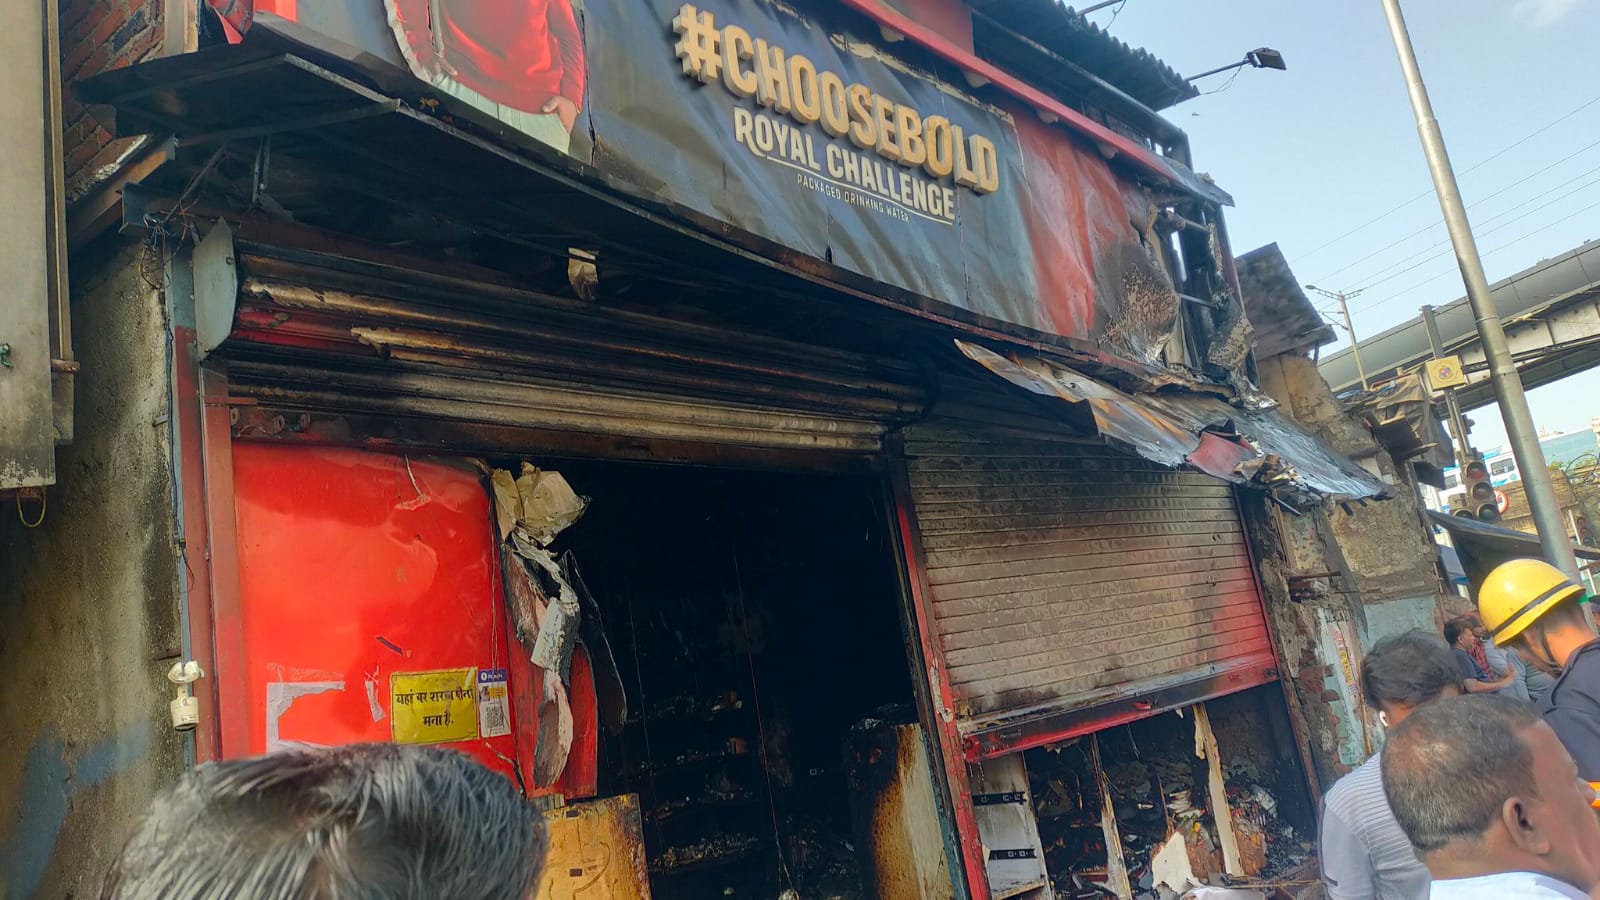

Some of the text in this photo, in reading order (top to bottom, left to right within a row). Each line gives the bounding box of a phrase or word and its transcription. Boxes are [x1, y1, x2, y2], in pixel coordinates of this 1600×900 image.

[672, 3, 998, 194] #CHOOSEBOLD
[734, 107, 956, 220] ROYAL CHALLENGE
[797, 173, 910, 222] PACKAGED DRINKING WATER
